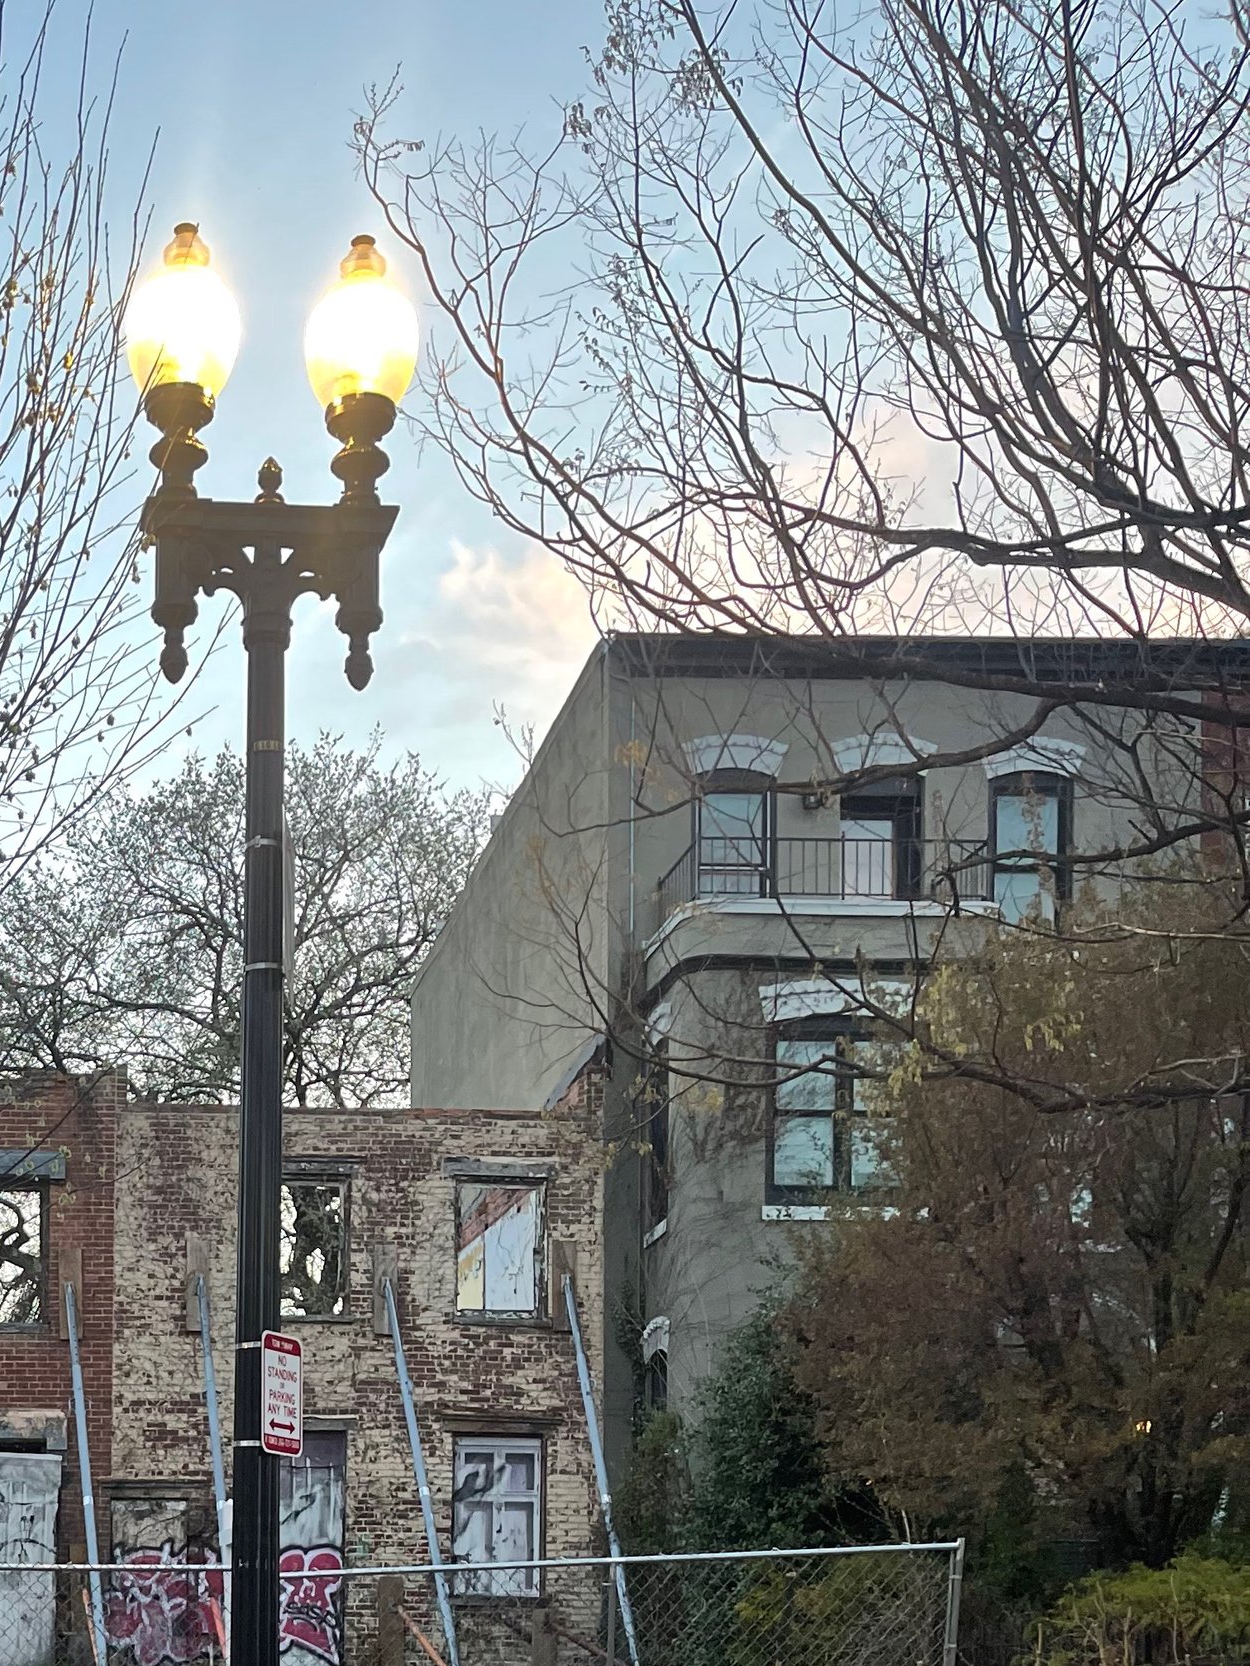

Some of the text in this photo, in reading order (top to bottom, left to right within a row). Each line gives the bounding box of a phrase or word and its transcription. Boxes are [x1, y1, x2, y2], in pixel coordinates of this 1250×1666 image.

[278, 1355, 287, 1367] NO
[268, 1366, 298, 1383] STANDING
[269, 1388, 295, 1405] PARKING
[268, 1403, 297, 1419] ANY TIME
